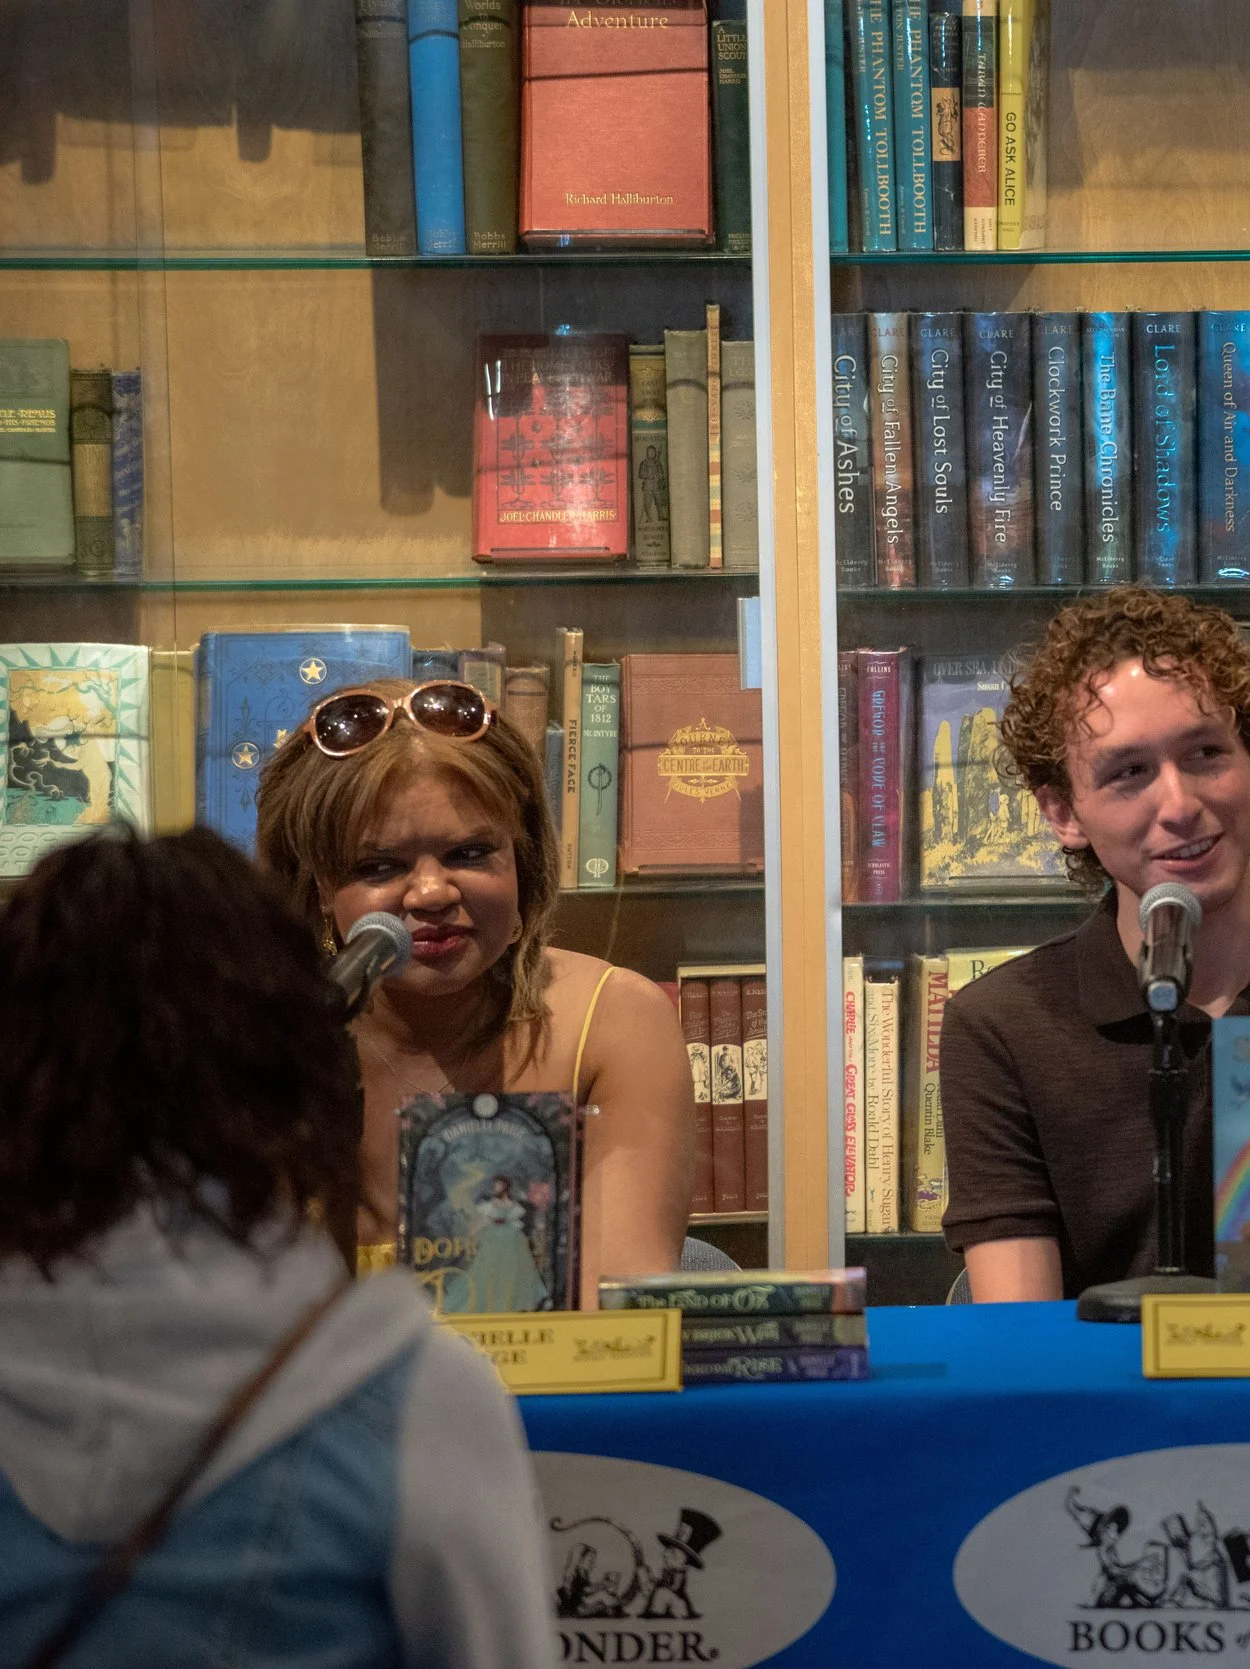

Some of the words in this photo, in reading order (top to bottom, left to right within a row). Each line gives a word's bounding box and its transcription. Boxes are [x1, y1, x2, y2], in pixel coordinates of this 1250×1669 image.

[566, 11, 669, 30] Adventure
[871, 31, 887, 121] PHANTOM
[909, 29, 924, 119] PHANTOM
[1006, 112, 1016, 132] GO
[1005, 136, 1016, 163] ASK
[875, 127, 891, 235] TOLLBOOTH
[912, 127, 927, 233] TOLLBOOTH
[1004, 168, 1016, 206] ALICE
[566, 192, 608, 206] Richard
[611, 192, 674, 206] Halliburton
[979, 329, 1015, 339] CLARE
[1146, 324, 1182, 334] CLARE
[834, 355, 857, 407] City
[877, 354, 899, 395] City
[927, 349, 949, 390] City
[986, 350, 1008, 390] City
[1099, 354, 1115, 383] The
[1154, 345, 1176, 400] Lord
[1221, 341, 1237, 388] Queen
[883, 400, 899, 415] of
[934, 396, 949, 411] of
[992, 396, 1008, 411] of
[1047, 346, 1068, 448] Clockwork
[1099, 388, 1117, 436] Bane
[1223, 393, 1237, 410] of
[837, 415, 858, 437] of
[932, 414, 950, 456] Lost
[1155, 406, 1177, 433] of
[1223, 412, 1236, 433] Air
[884, 421, 901, 477] Fallen
[989, 415, 1011, 503] Heavenly
[1224, 436, 1237, 463] and
[837, 440, 860, 514] Ashes
[934, 462, 953, 514] Souls
[1049, 452, 1067, 512] Prince
[1100, 440, 1120, 543] Chronicles
[1155, 434, 1179, 533] Shadows
[881, 480, 904, 544] Angels
[1223, 466, 1238, 532] Darkness
[994, 508, 1011, 543] Fire
[586, 694, 617, 704] TARS
[590, 684, 611, 693] BOY
[976, 681, 1000, 692] Susan
[591, 714, 612, 723] 1812
[567, 719, 577, 793] FIERCE-FACE
[663, 758, 701, 772] CENTRE
[713, 758, 744, 772] EARTH
[881, 989, 894, 1015] The
[926, 971, 949, 1074] MATILDA
[881, 1016, 894, 1084] Wonderful
[845, 1064, 858, 1101] GREAT
[924, 1082, 935, 1120] Quentin
[845, 1103, 856, 1132] GLASS
[868, 1092, 879, 1125] Roald
[881, 1088, 894, 1125] Story
[868, 1134, 880, 1169] Dahl
[882, 1127, 894, 1139] of
[923, 1127, 932, 1155] Blake
[844, 1133, 856, 1198] ELEVATOR
[881, 1142, 894, 1184] Henry
[880, 1188, 894, 1226] Sugar
[1068, 1620, 1225, 1654] BOOKS
